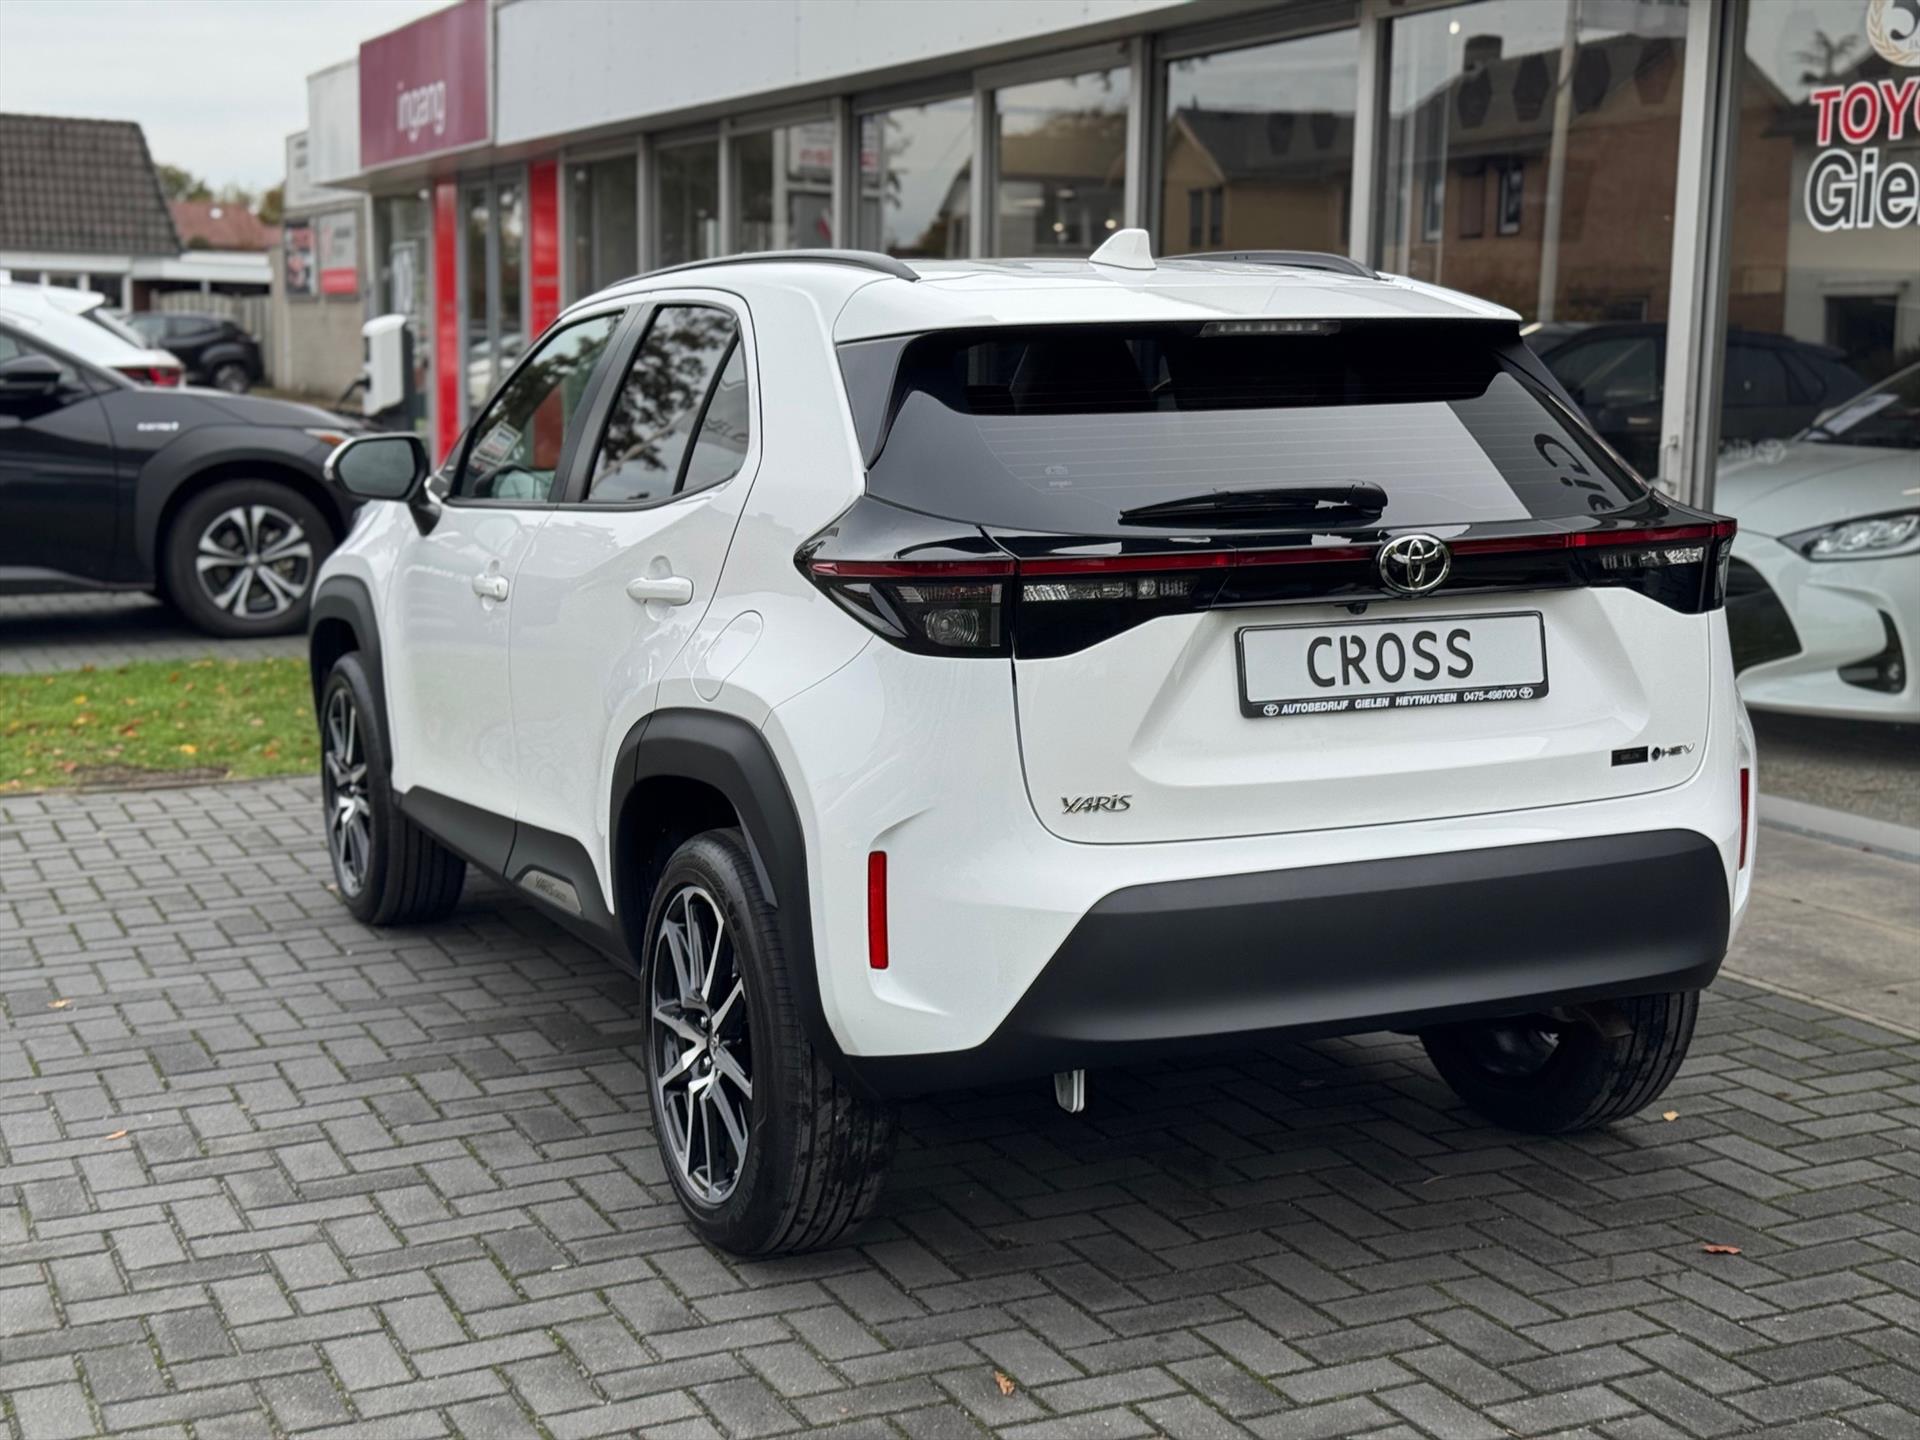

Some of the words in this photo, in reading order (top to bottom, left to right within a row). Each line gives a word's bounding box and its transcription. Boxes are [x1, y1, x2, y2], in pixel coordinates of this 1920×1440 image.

[397, 81, 445, 141] ingang
[1811, 77, 1920, 147] TOY
[1307, 628, 1474, 687] CROSS
[1281, 700, 1349, 714] AUTOBEDRIJF
[1355, 697, 1390, 709] GIELEN
[1395, 693, 1457, 706] HEYTHUYSEN
